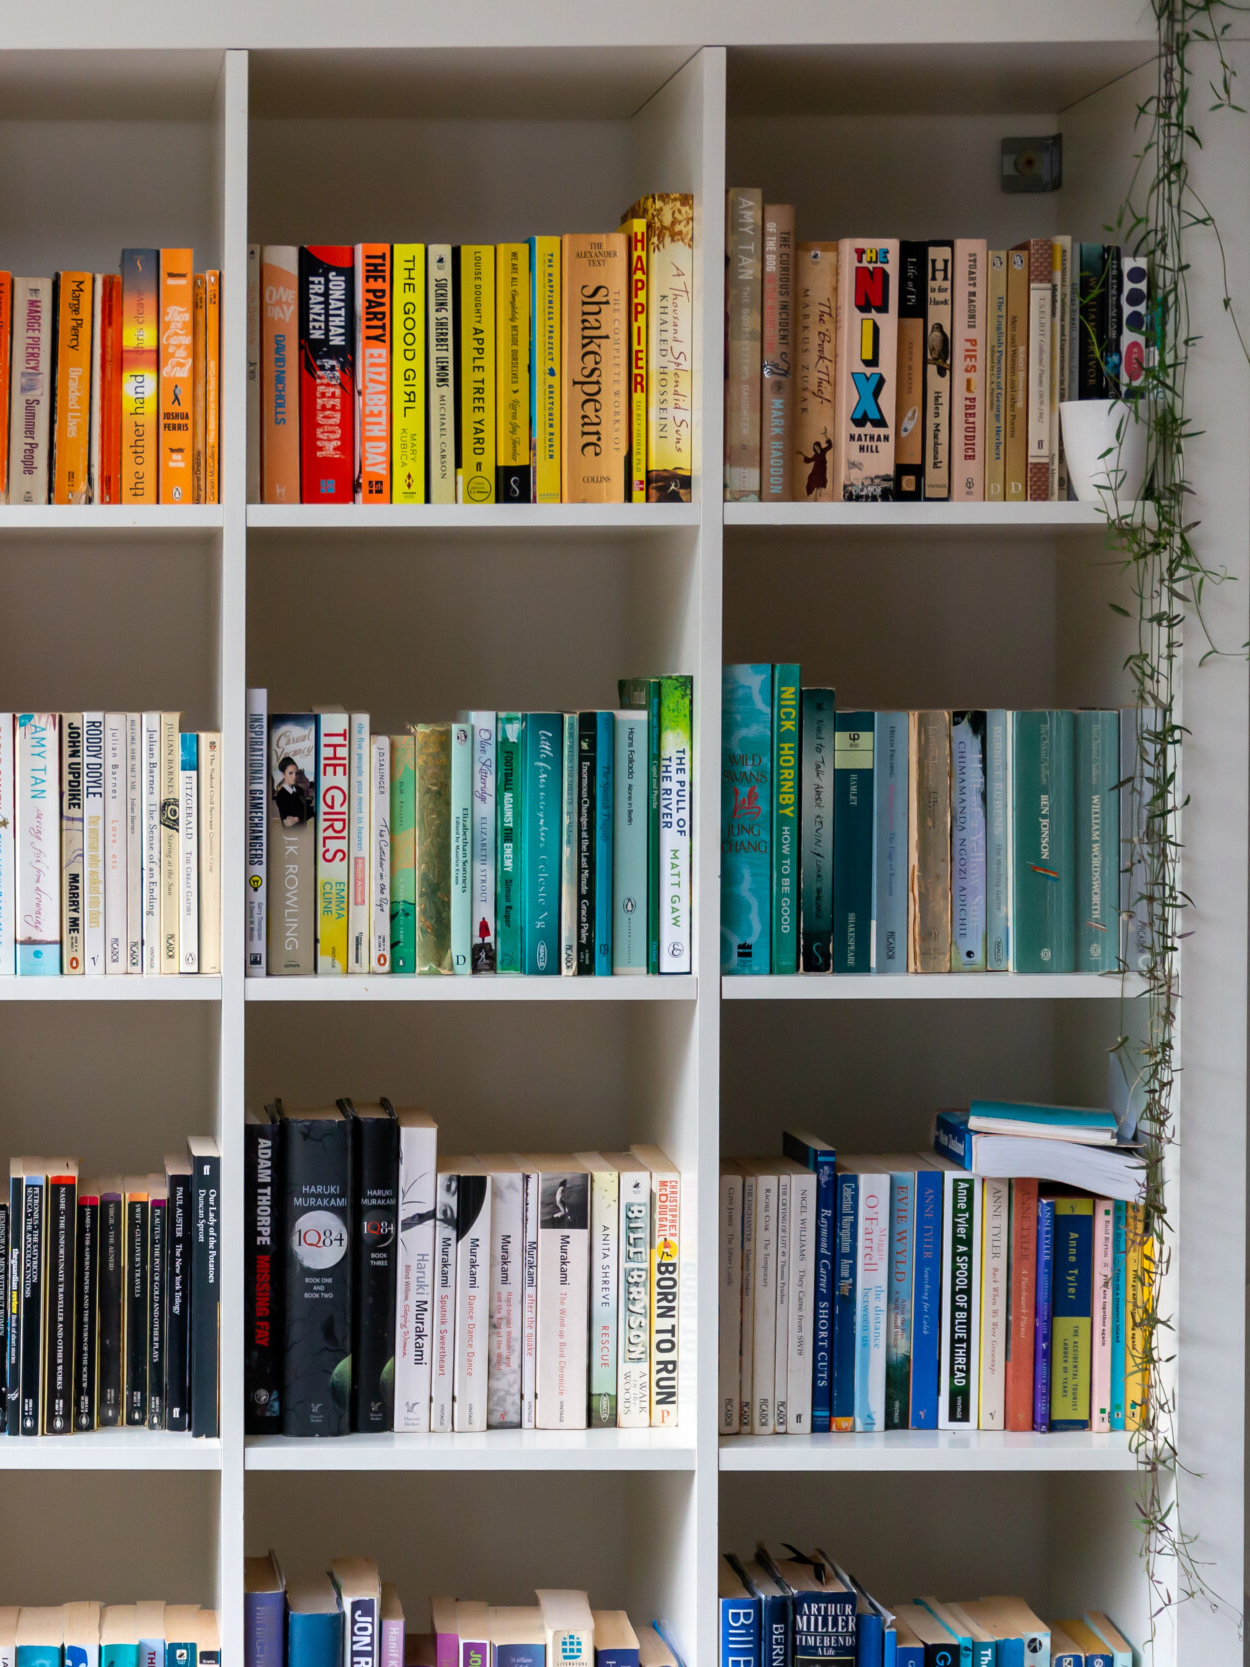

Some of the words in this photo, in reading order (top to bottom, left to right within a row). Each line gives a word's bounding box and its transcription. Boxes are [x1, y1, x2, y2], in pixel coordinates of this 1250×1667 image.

[589, 242, 604, 250] THE
[855, 248, 888, 263] THE
[365, 252, 386, 283] THE
[931, 259, 949, 281] H
[27, 300, 41, 333] MARGE
[309, 276, 325, 340] FRANZEN
[329, 271, 346, 346] JONATHAN
[366, 289, 386, 344] PARTY
[633, 231, 646, 393] HAPPIER
[25, 337, 41, 371] PIERCY
[851, 266, 889, 428] NIX
[964, 339, 977, 374] PIES
[573, 284, 610, 456] Shakespeare
[130, 374, 145, 416] hand
[364, 349, 386, 437] ELIZABETH
[23, 399, 40, 436] Summer
[163, 412, 189, 420] JOSHUA
[771, 399, 783, 435] MARK
[964, 397, 976, 461] PREJUDICE
[20, 439, 39, 475] People
[130, 421, 145, 466] other
[365, 441, 386, 475] DAY
[859, 444, 879, 453] HILL
[933, 423, 941, 469] Macdonald
[130, 471, 145, 497] the
[770, 440, 783, 494] HADDON
[780, 687, 796, 732] NICK
[68, 722, 81, 758] JOHN
[322, 729, 347, 777] THE
[628, 727, 636, 747] Hans
[662, 756, 672, 779] THE
[722, 771, 767, 783] SWANS
[728, 754, 762, 765] WILD
[68, 761, 81, 810] UPDIKE
[778, 743, 795, 817] HORNBY
[185, 775, 193, 840] FITZGERALD
[662, 784, 672, 829] RIVER
[1040, 794, 1048, 815] BEN
[1092, 794, 1100, 840] WILLIAM
[322, 786, 347, 863] GIRLS
[728, 823, 760, 837] JUNG
[1039, 818, 1049, 860] JONSON
[722, 840, 767, 853] CHANG
[670, 849, 680, 889] MATT
[1091, 843, 1100, 918] WORDSWORTH
[322, 882, 332, 916] CLINE
[334, 881, 345, 920] EMMA
[670, 896, 680, 928] GAW
[257, 1138, 271, 1174] ADAM
[256, 1179, 270, 1246] THORPE
[293, 1198, 347, 1207] MURAKAMI
[897, 1185, 909, 1221] EVIE
[197, 1219, 205, 1242] Sprott
[296, 1229, 345, 1248] 1Q84
[819, 1208, 831, 1256] Raymond
[1069, 1232, 1078, 1262] Anne
[500, 1234, 512, 1286] Murakami
[895, 1226, 907, 1283] WYLD
[256, 1255, 270, 1321] MISSING
[656, 1262, 678, 1320] BORN
[819, 1260, 831, 1294] Carver
[875, 1285, 885, 1303] the
[1068, 1269, 1076, 1300] Tyler
[255, 1324, 269, 1347] FAY
[655, 1324, 676, 1354] TO
[819, 1301, 829, 1341] SHORT
[874, 1306, 882, 1349] distance
[656, 1360, 677, 1406] RUN
[818, 1345, 828, 1388] CUTS
[795, 1616, 857, 1632] MILLER
[801, 1603, 852, 1616] ARTHUR
[353, 1610, 372, 1651] JON
[727, 1609, 754, 1649] Bill
[795, 1634, 857, 1646] TIMEBENDS
